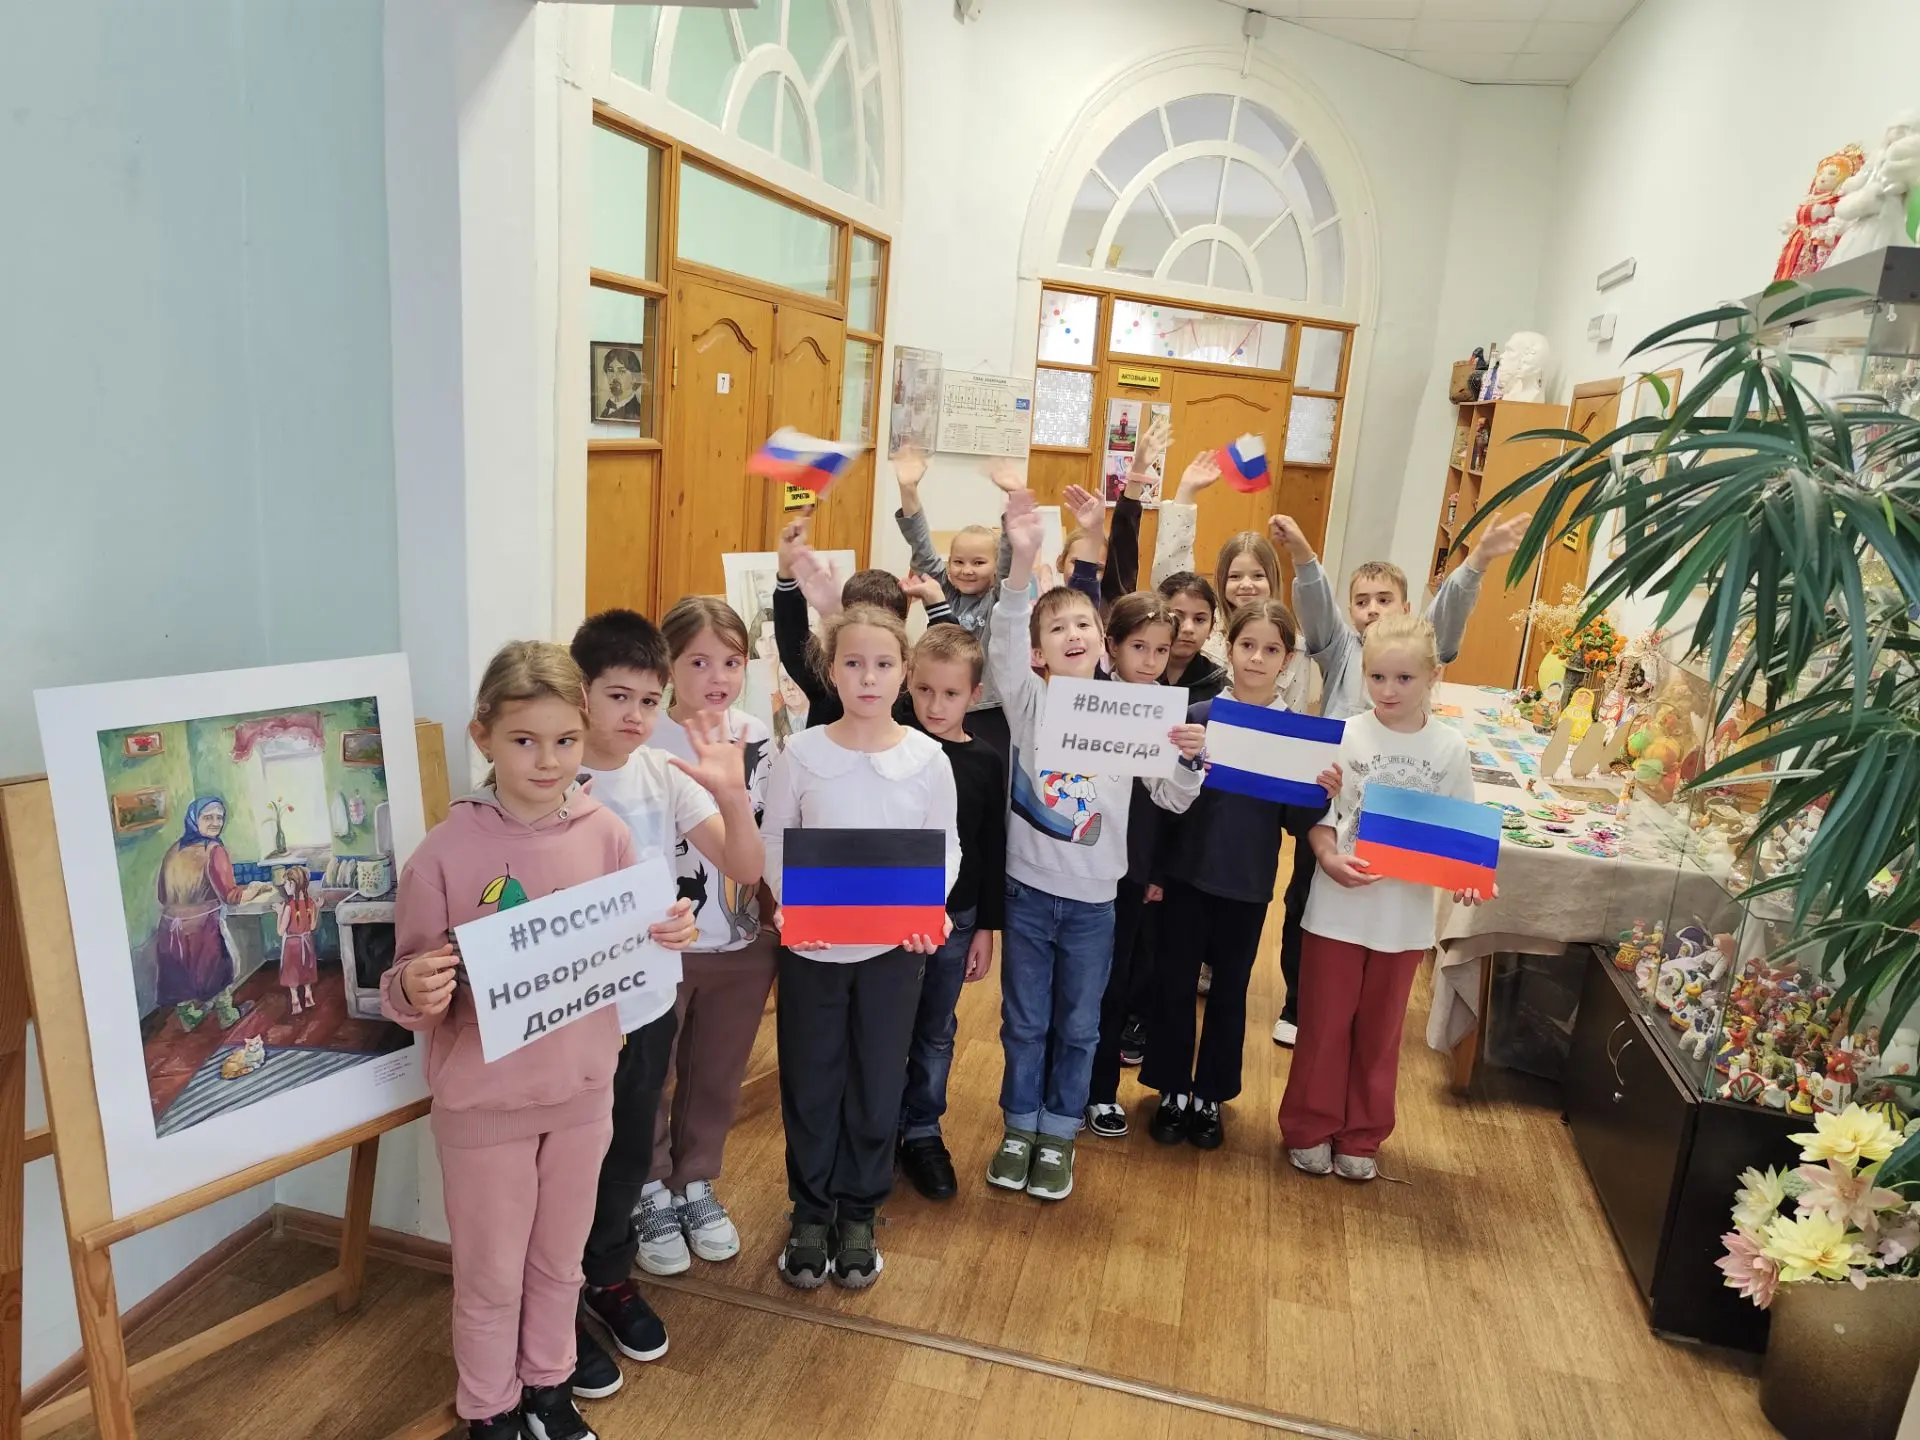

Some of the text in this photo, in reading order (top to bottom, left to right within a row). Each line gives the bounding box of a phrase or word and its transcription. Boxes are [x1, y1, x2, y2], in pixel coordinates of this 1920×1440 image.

[1148, 375, 1159, 383] ЗАЛ
[1073, 693, 1164, 720] #Вместе
[1061, 733, 1161, 759] Навсегда
[509, 891, 637, 951] #Россия
[488, 927, 651, 1010] Новоросси
[523, 969, 647, 1041] Донбасс
